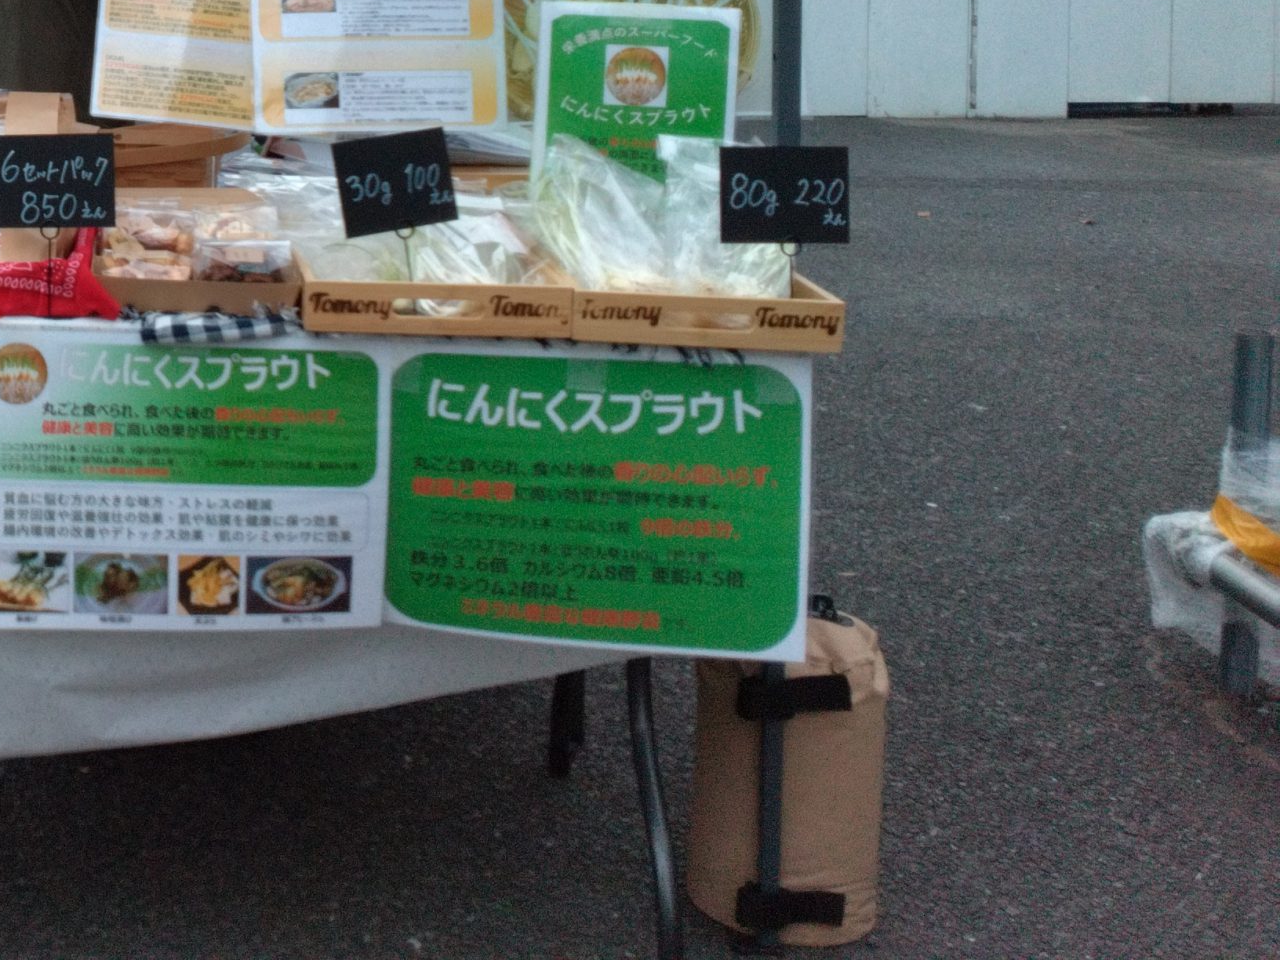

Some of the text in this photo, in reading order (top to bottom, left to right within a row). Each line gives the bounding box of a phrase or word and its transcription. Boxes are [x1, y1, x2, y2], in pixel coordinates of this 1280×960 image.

[561, 95, 712, 126] にんにくスプラウト
[1, 149, 109, 187] 6セットパック
[345, 163, 441, 206] 30g 100
[729, 172, 845, 217] 80g 220
[309, 292, 395, 319] Tomony
[581, 298, 840, 335] Tomony Tomony
[60, 348, 332, 392] にんにくスプラウト
[427, 378, 763, 436] にんにくスプラウト
